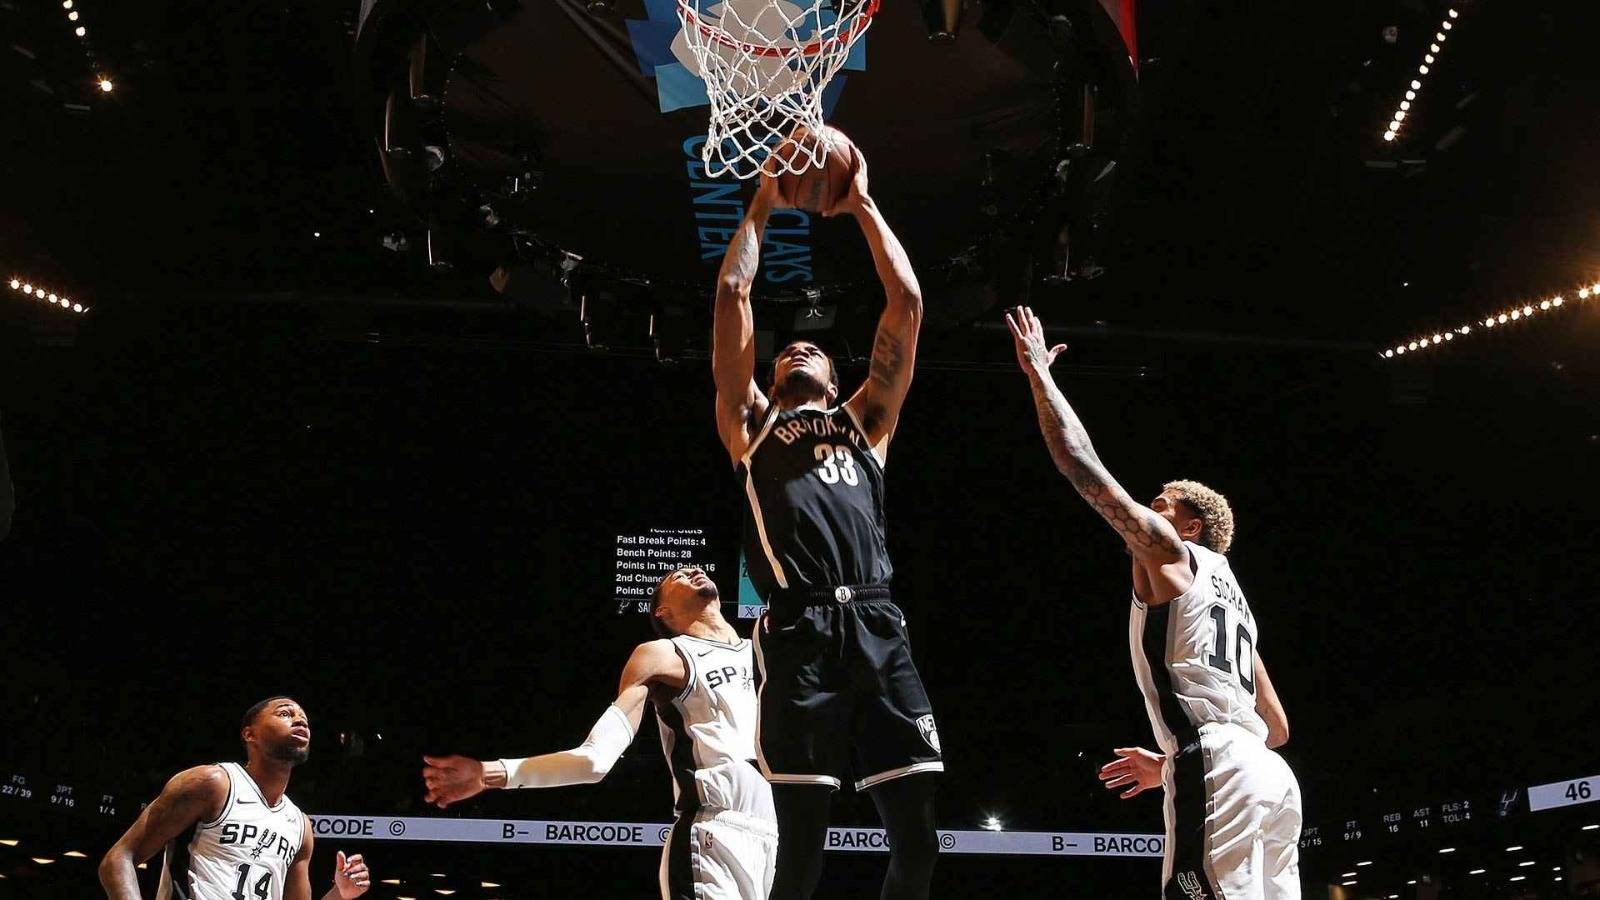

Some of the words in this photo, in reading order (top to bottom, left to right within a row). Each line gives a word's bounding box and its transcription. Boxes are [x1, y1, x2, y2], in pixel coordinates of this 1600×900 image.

[814, 443, 859, 487] 33
[617, 535, 636, 544] Fast
[638, 536, 665, 545] Break
[667, 536, 699, 545] Points:
[700, 538, 706, 546] 4
[617, 548, 645, 557] Bench
[648, 549, 679, 558] Points:
[681, 550, 692, 558] 28
[616, 561, 644, 570] Points
[647, 562, 656, 570] In
[658, 562, 675, 570] The
[705, 563, 716, 572] 16
[616, 573, 633, 582] 2nd
[616, 586, 645, 595] Points
[1208, 605, 1255, 695] 10
[56, 784, 73, 795] 3PT
[1565, 781, 1591, 800] 46
[103, 794, 114, 803] FT
[1464, 801, 1469, 809] 2
[1383, 813, 1401, 822] REB
[1413, 808, 1430, 818] AST
[1465, 812, 1470, 820] 4
[1346, 821, 1357, 829] FT
[1420, 820, 1429, 828] 11
[545, 824, 643, 842] BARCODE
[219, 823, 296, 869] SPURS
[231, 863, 273, 900] 14
